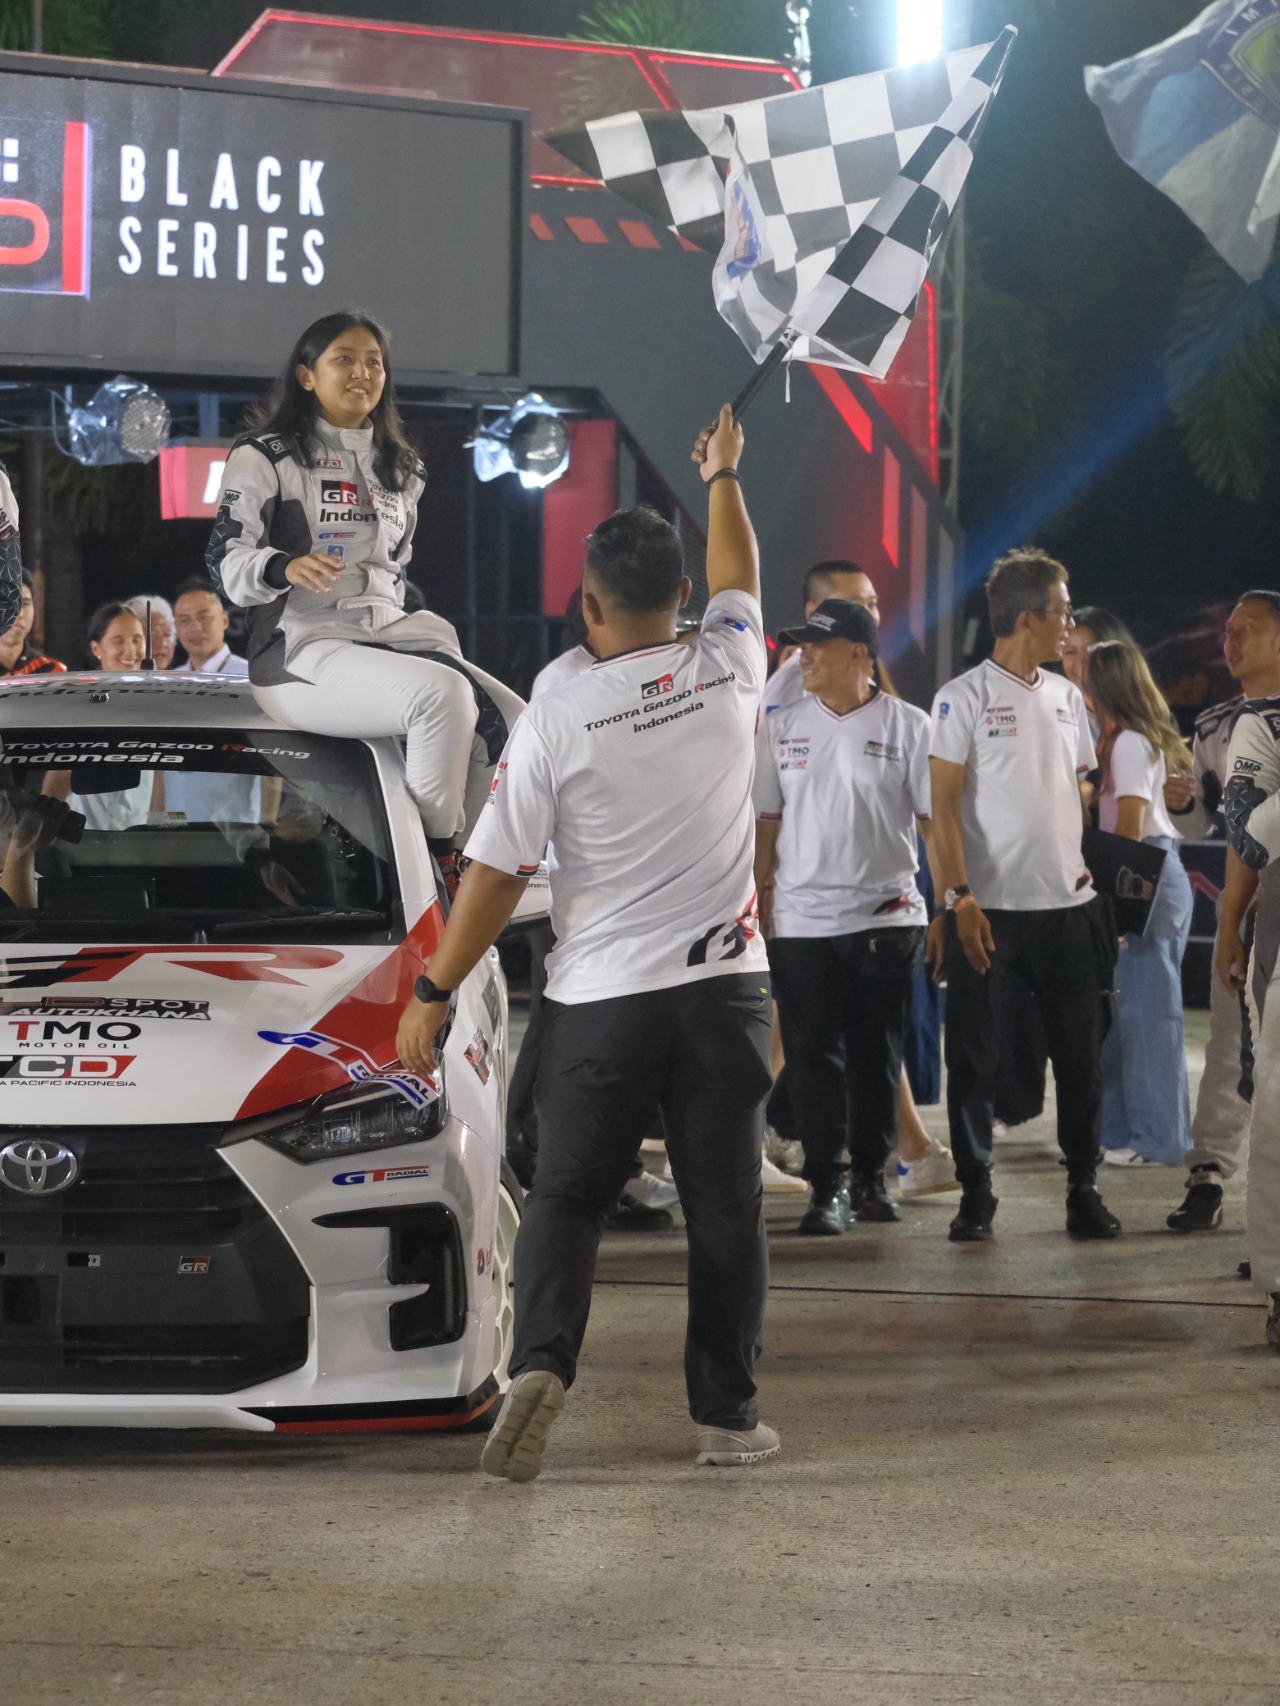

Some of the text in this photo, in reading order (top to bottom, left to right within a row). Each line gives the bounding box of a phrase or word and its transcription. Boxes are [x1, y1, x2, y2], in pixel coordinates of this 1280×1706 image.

[120, 144, 325, 217] BLACK
[118, 215, 325, 286] SERIES
[323, 489, 358, 505] GR
[642, 681, 674, 699] GR
[584, 672, 736, 732] TOYOTA GAZOO Racing
[633, 702, 704, 733] Indonesia
[996, 715, 1017, 723] TMO
[5, 741, 311, 759] TOYOTA GAZOO Racing
[787, 746, 810, 755] TMO
[1234, 760, 1261, 773] OMP
[110, 998, 210, 1010] SPOT
[10, 1006, 211, 1020] AUTOKHANA
[8, 1021, 142, 1041] TMO
[332, 1168, 429, 1185] GT RADIAL
